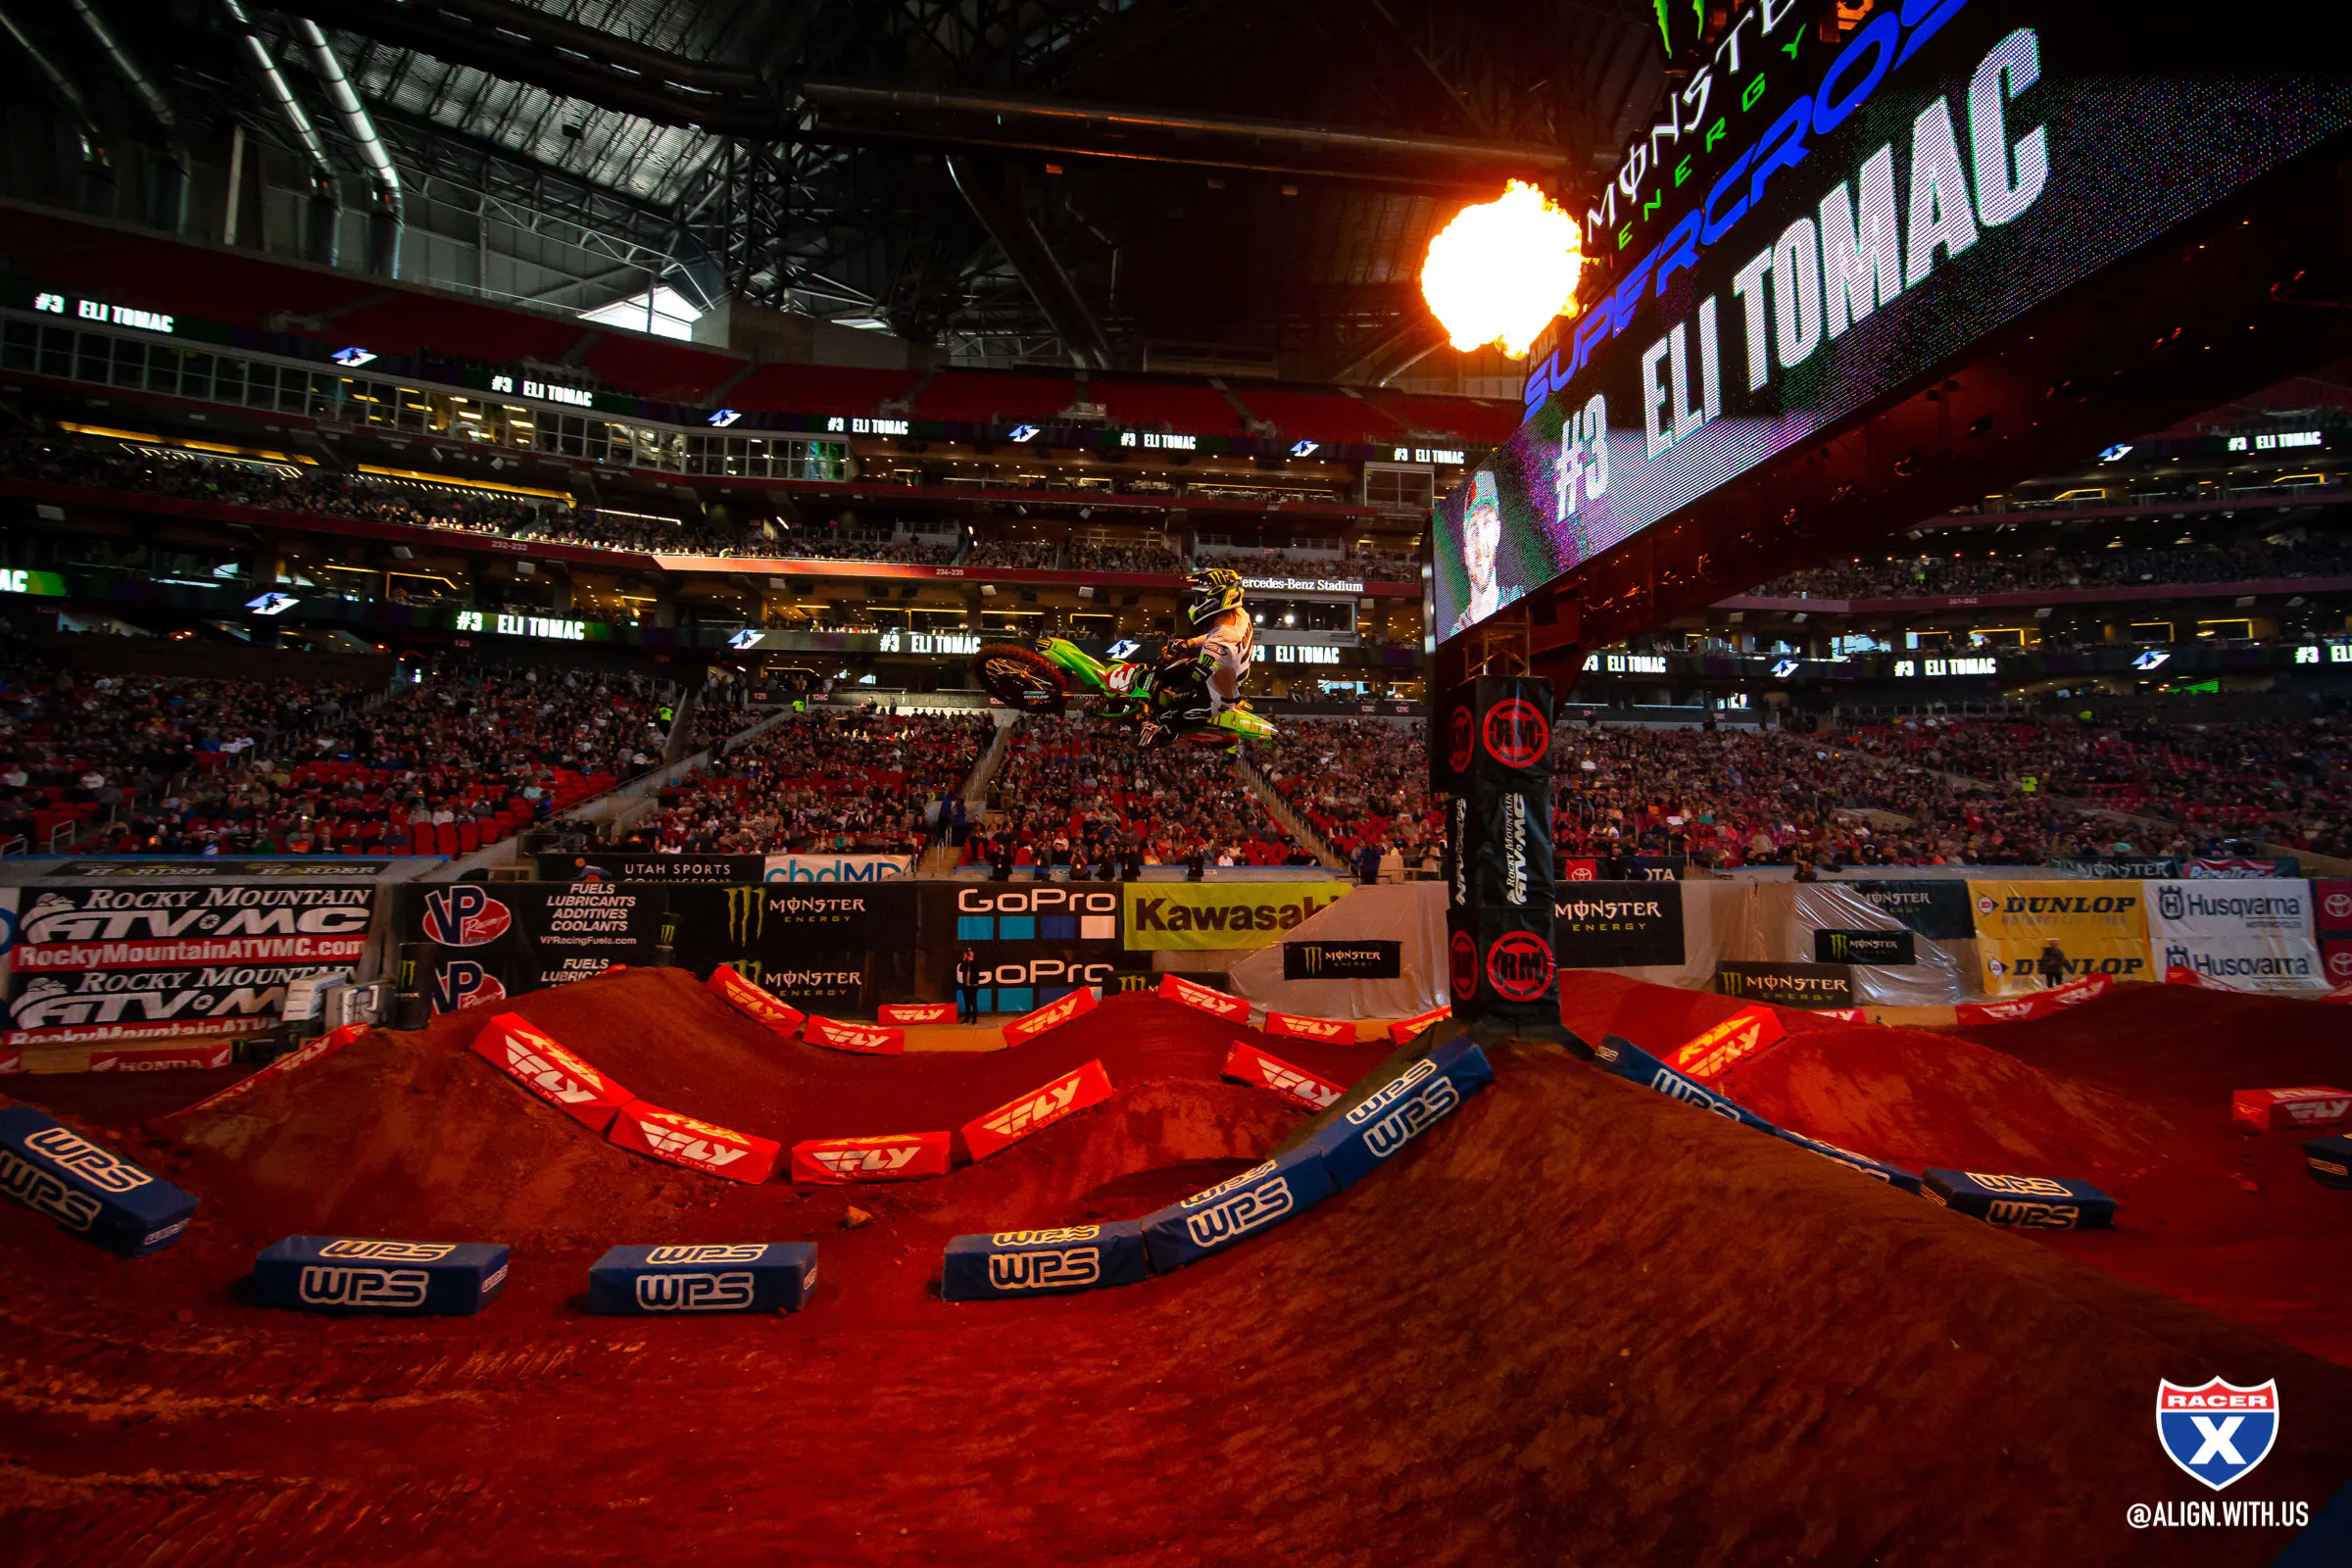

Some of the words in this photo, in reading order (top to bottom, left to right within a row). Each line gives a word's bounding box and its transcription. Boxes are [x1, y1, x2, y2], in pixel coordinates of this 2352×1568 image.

[1618, 24, 1807, 251] ENERGY
[1555, 393, 1609, 523] #3
[1642, 294, 1722, 463] ELI
[1733, 27, 2048, 392] TOMAC
[34, 292, 65, 314] #3
[78, 299, 109, 321] ELI
[112, 305, 174, 333] TOMAC
[491, 375, 513, 393] #3
[522, 380, 545, 400] ELI
[547, 384, 593, 407] TOMAC
[827, 416, 845, 432] #3
[852, 417, 870, 433] ELI
[871, 418, 908, 435] TOMAC
[1120, 432, 1137, 447] #3
[1144, 433, 1160, 448] ELI
[1161, 434, 1197, 450] TOMAC
[1394, 447, 1409, 462] #3
[1415, 448, 1431, 463] ELI
[1432, 450, 1465, 465] TOMAC
[1240, 576, 1315, 591] ercedes-Benz
[1317, 578, 1364, 592] Stadium
[456, 611, 483, 632] #3
[497, 614, 524, 635] ELI
[528, 616, 585, 641] TOMAC
[880, 635, 900, 653] #3
[910, 635, 931, 654] ELI
[936, 636, 981, 655] TOMAC
[1275, 645, 1296, 663] ELI
[1297, 646, 1341, 664] TOMAC
[2294, 646, 2320, 664] #3
[1607, 655, 1625, 672] ELI
[1627, 656, 1666, 673] TOMAC
[1925, 660, 1947, 676] ELI
[1947, 658, 1997, 676] TOMAC
[1504, 792, 1514, 852] MOUNTAIN
[624, 863, 666, 875] UTAH
[673, 863, 732, 875] SPORTS
[1505, 851, 1515, 888] ROCKY
[81, 889, 199, 909] ROCKY
[200, 887, 372, 906] MOUNTAIN
[569, 883, 615, 894] FUELS
[545, 896, 637, 907] LUBRICANTS
[769, 896, 866, 913] MONSTER
[957, 888, 1116, 912] GoPro
[1554, 899, 1662, 921] MONSTER
[2003, 897, 2136, 912] DUNLOP
[2186, 894, 2301, 918] Husqvarna
[552, 908, 628, 919] ADDITIVES
[1135, 896, 1340, 931] Kawasak
[550, 920, 628, 932] COOLANTS
[1572, 922, 1647, 932] ENERGY
[540, 935, 637, 947] VPRacingFuels.com
[19, 938, 366, 969] RockyMountainATVMC.com
[563, 957, 610, 969] FUELS
[1325, 949, 1383, 961] MONSTER
[74, 971, 193, 994] ROCKY
[765, 969, 862, 987] MONSTER
[1746, 974, 1850, 993] MONSTER
[725, 980, 785, 1019] FLY
[1176, 984, 1238, 1013] FLY
[889, 1008, 945, 1020] FLY
[1014, 998, 1078, 1034] FLY
[821, 1025, 890, 1048] FLY
[1281, 1016, 1343, 1037] FLY
[118, 1058, 204, 1072] HONDA
[506, 1035, 598, 1103] FLY
[1257, 1056, 1347, 1108] FLY
[1346, 1058, 1438, 1125] WPS
[982, 1076, 1081, 1136] FLY
[1363, 1076, 1460, 1158] WPS
[639, 1121, 749, 1165] FLY
[24, 1126, 154, 1193] WPS
[812, 1147, 921, 1172] FLY
[1190, 1176, 1295, 1249] WPS
[1985, 1199, 2080, 1230] WPS
[318, 1240, 457, 1262] WPS
[646, 1244, 769, 1266] WPS
[988, 1247, 1101, 1290] WPS
[299, 1266, 429, 1308] WPS
[635, 1271, 755, 1312] WPS
